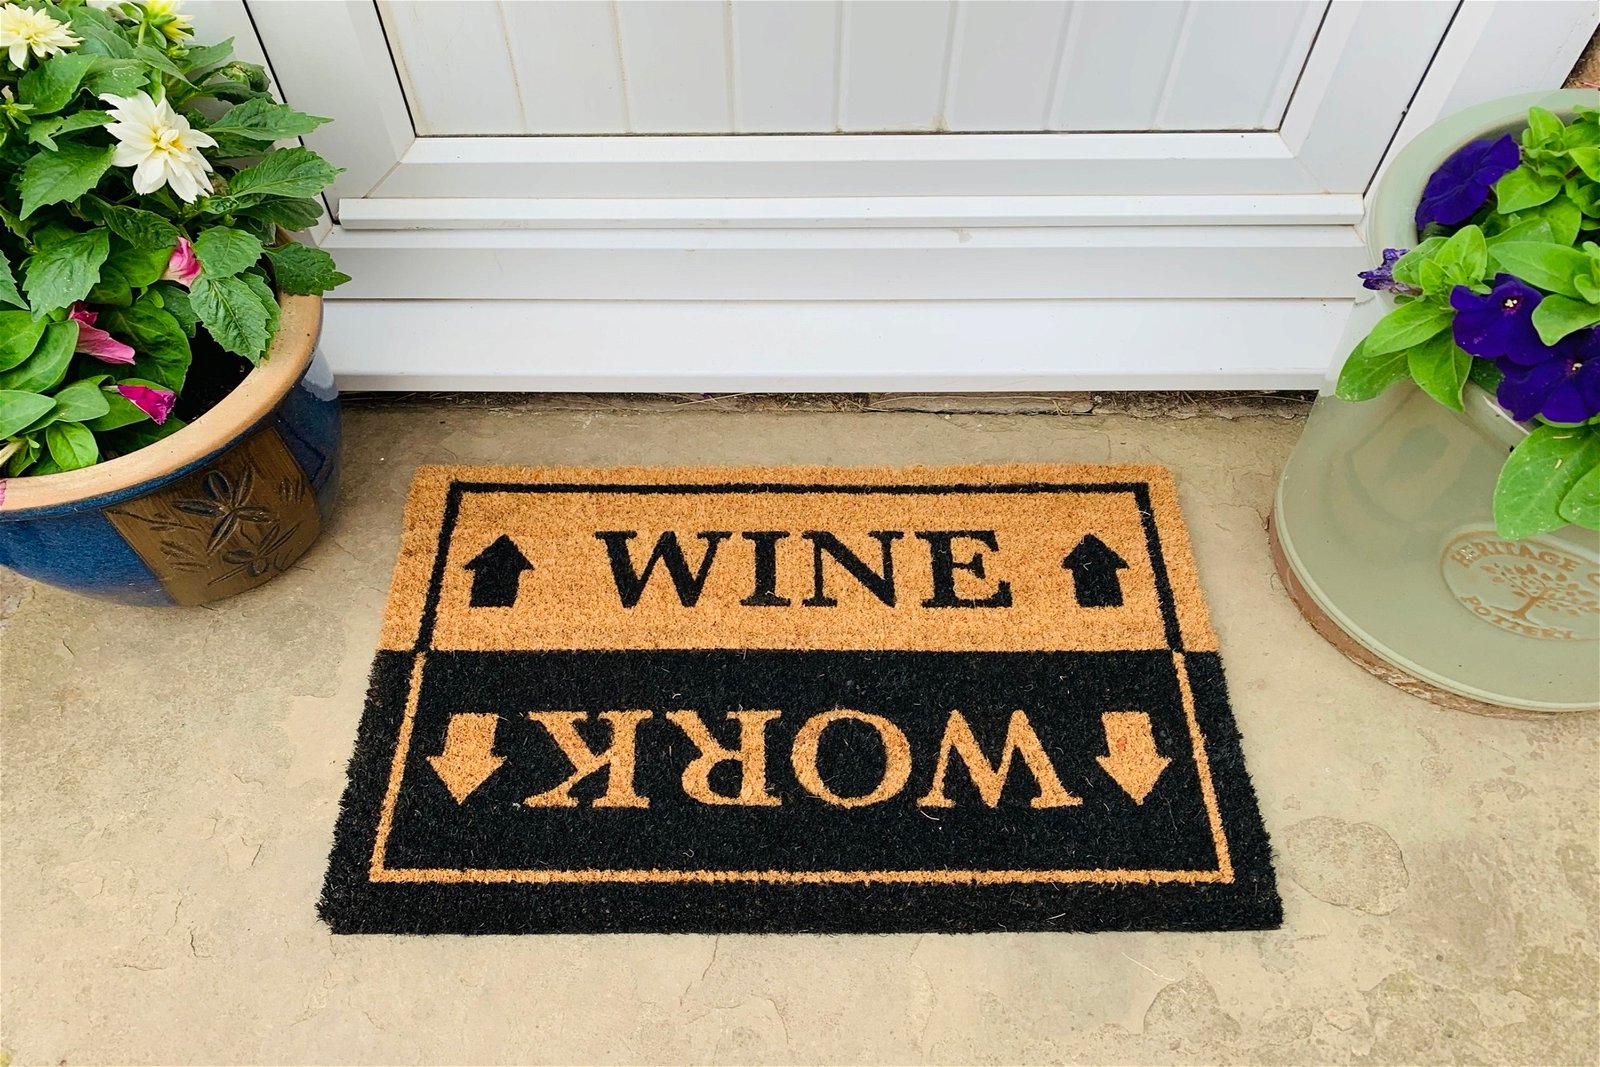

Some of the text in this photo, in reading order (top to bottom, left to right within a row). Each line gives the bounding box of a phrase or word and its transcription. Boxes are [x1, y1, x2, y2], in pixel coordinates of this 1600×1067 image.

[595, 530, 1013, 609] WINE
[1451, 541, 1581, 572] HERITAGE
[524, 708, 1083, 809] WORK
